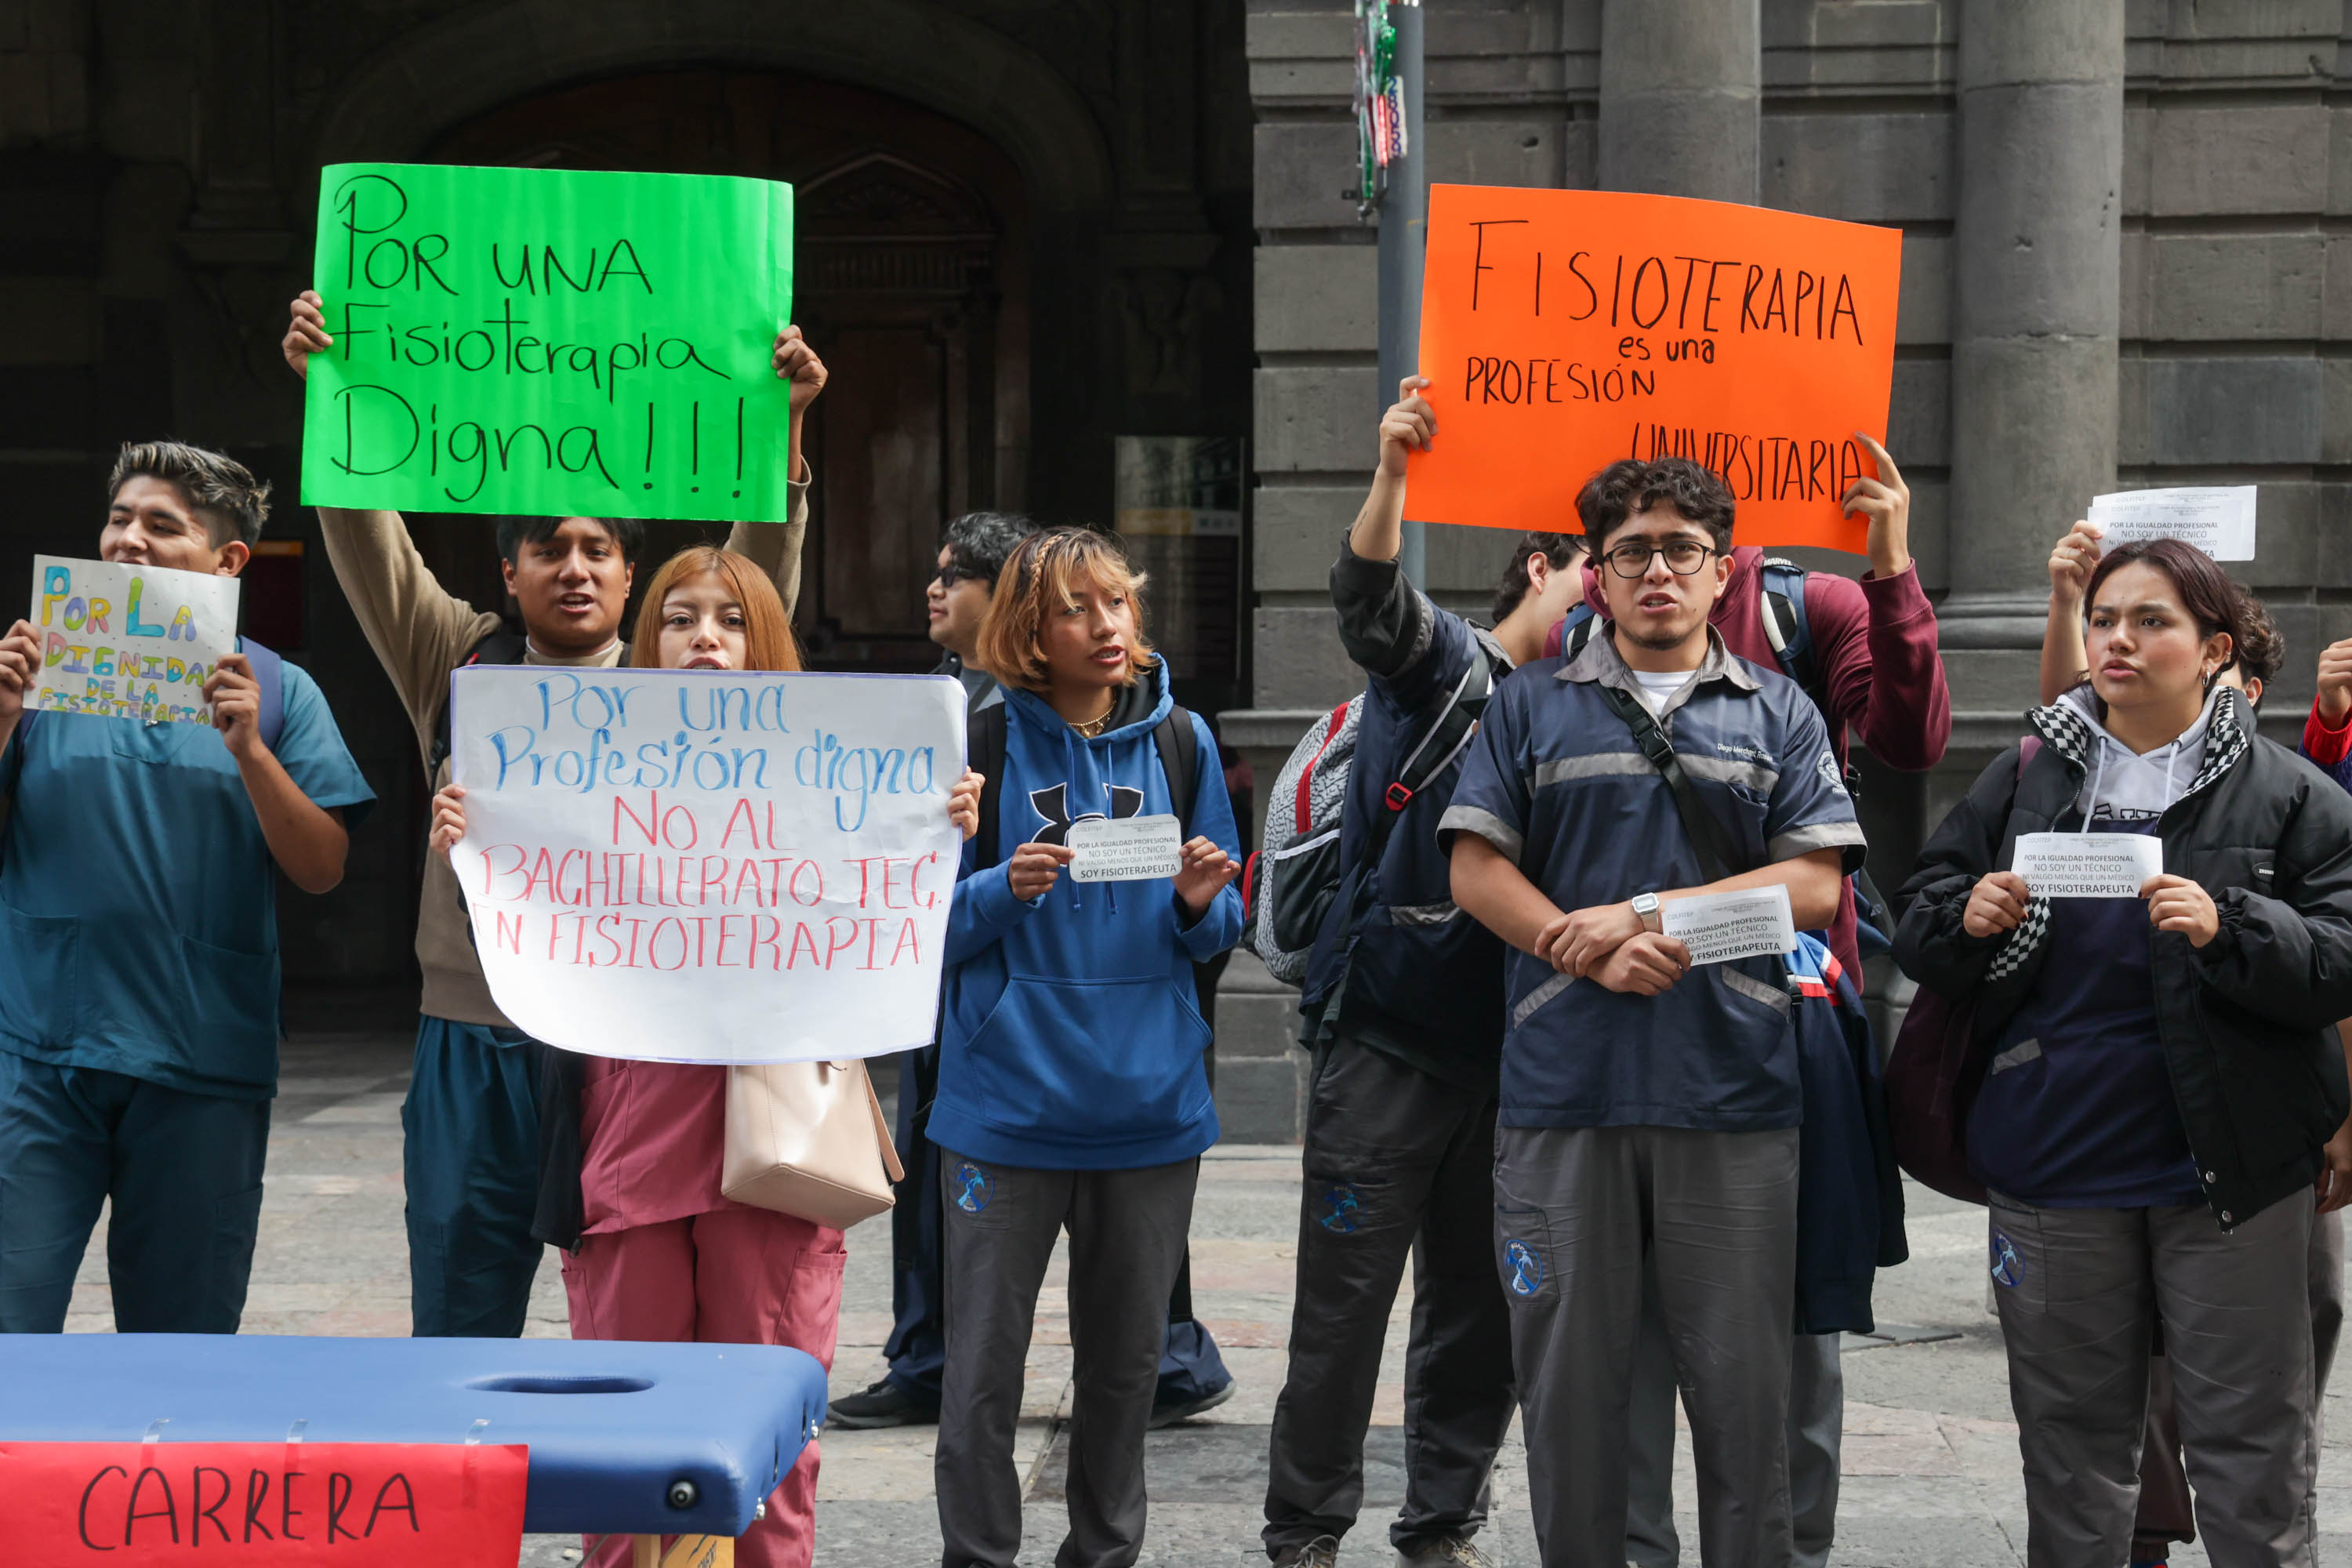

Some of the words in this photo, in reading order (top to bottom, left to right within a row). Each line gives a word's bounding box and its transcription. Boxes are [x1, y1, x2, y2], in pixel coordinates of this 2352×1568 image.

[335, 176, 458, 295] POR
[1469, 220, 1863, 346] FISIOTERAPIA
[325, 299, 731, 405] Fisioterapia
[1619, 336, 1650, 360] es
[1667, 337, 1714, 363] una
[1465, 358, 1654, 405] PROFESIÓN
[2170, 529, 2207, 539] TÉCNICO
[1763, 557, 1792, 566] MARVEL
[41, 565, 111, 634] POR
[126, 577, 196, 641] LA
[87, 677, 115, 699] DE
[127, 680, 158, 704] LA
[532, 673, 647, 731] Por
[678, 683, 789, 732] una
[39, 687, 210, 724] FISIOTERAPIA
[485, 726, 771, 793] Profesión
[795, 729, 940, 832] digna
[612, 789, 698, 851] NO
[721, 798, 797, 851] AL
[1100, 839, 1133, 848] IGUALDAD
[1134, 837, 1176, 846] PROFESIONAL
[1133, 845, 1166, 855] TÉCNICO
[480, 843, 823, 908] BACHILLERATO
[1081, 869, 1098, 879] SOY
[1102, 864, 1176, 877] FISIOTERAPEUTA
[2085, 862, 2122, 872] TÉCNICO
[2107, 873, 2134, 881] MÉDICO
[2025, 884, 2045, 892] SOY
[2049, 884, 2133, 893] FISIOTERAPEUTA
[1681, 937, 1694, 946] NO
[1697, 934, 1713, 942] SOY
[1732, 924, 1768, 935] TÉCNICO
[1693, 922, 1730, 935] IGUALDAD
[1731, 916, 1778, 927] PROFESIONAL
[549, 910, 919, 971] FISIOTERAPIA
[1697, 942, 1780, 960] FISIOTERAPEUTA
[78, 1465, 420, 1551] CARRERA
